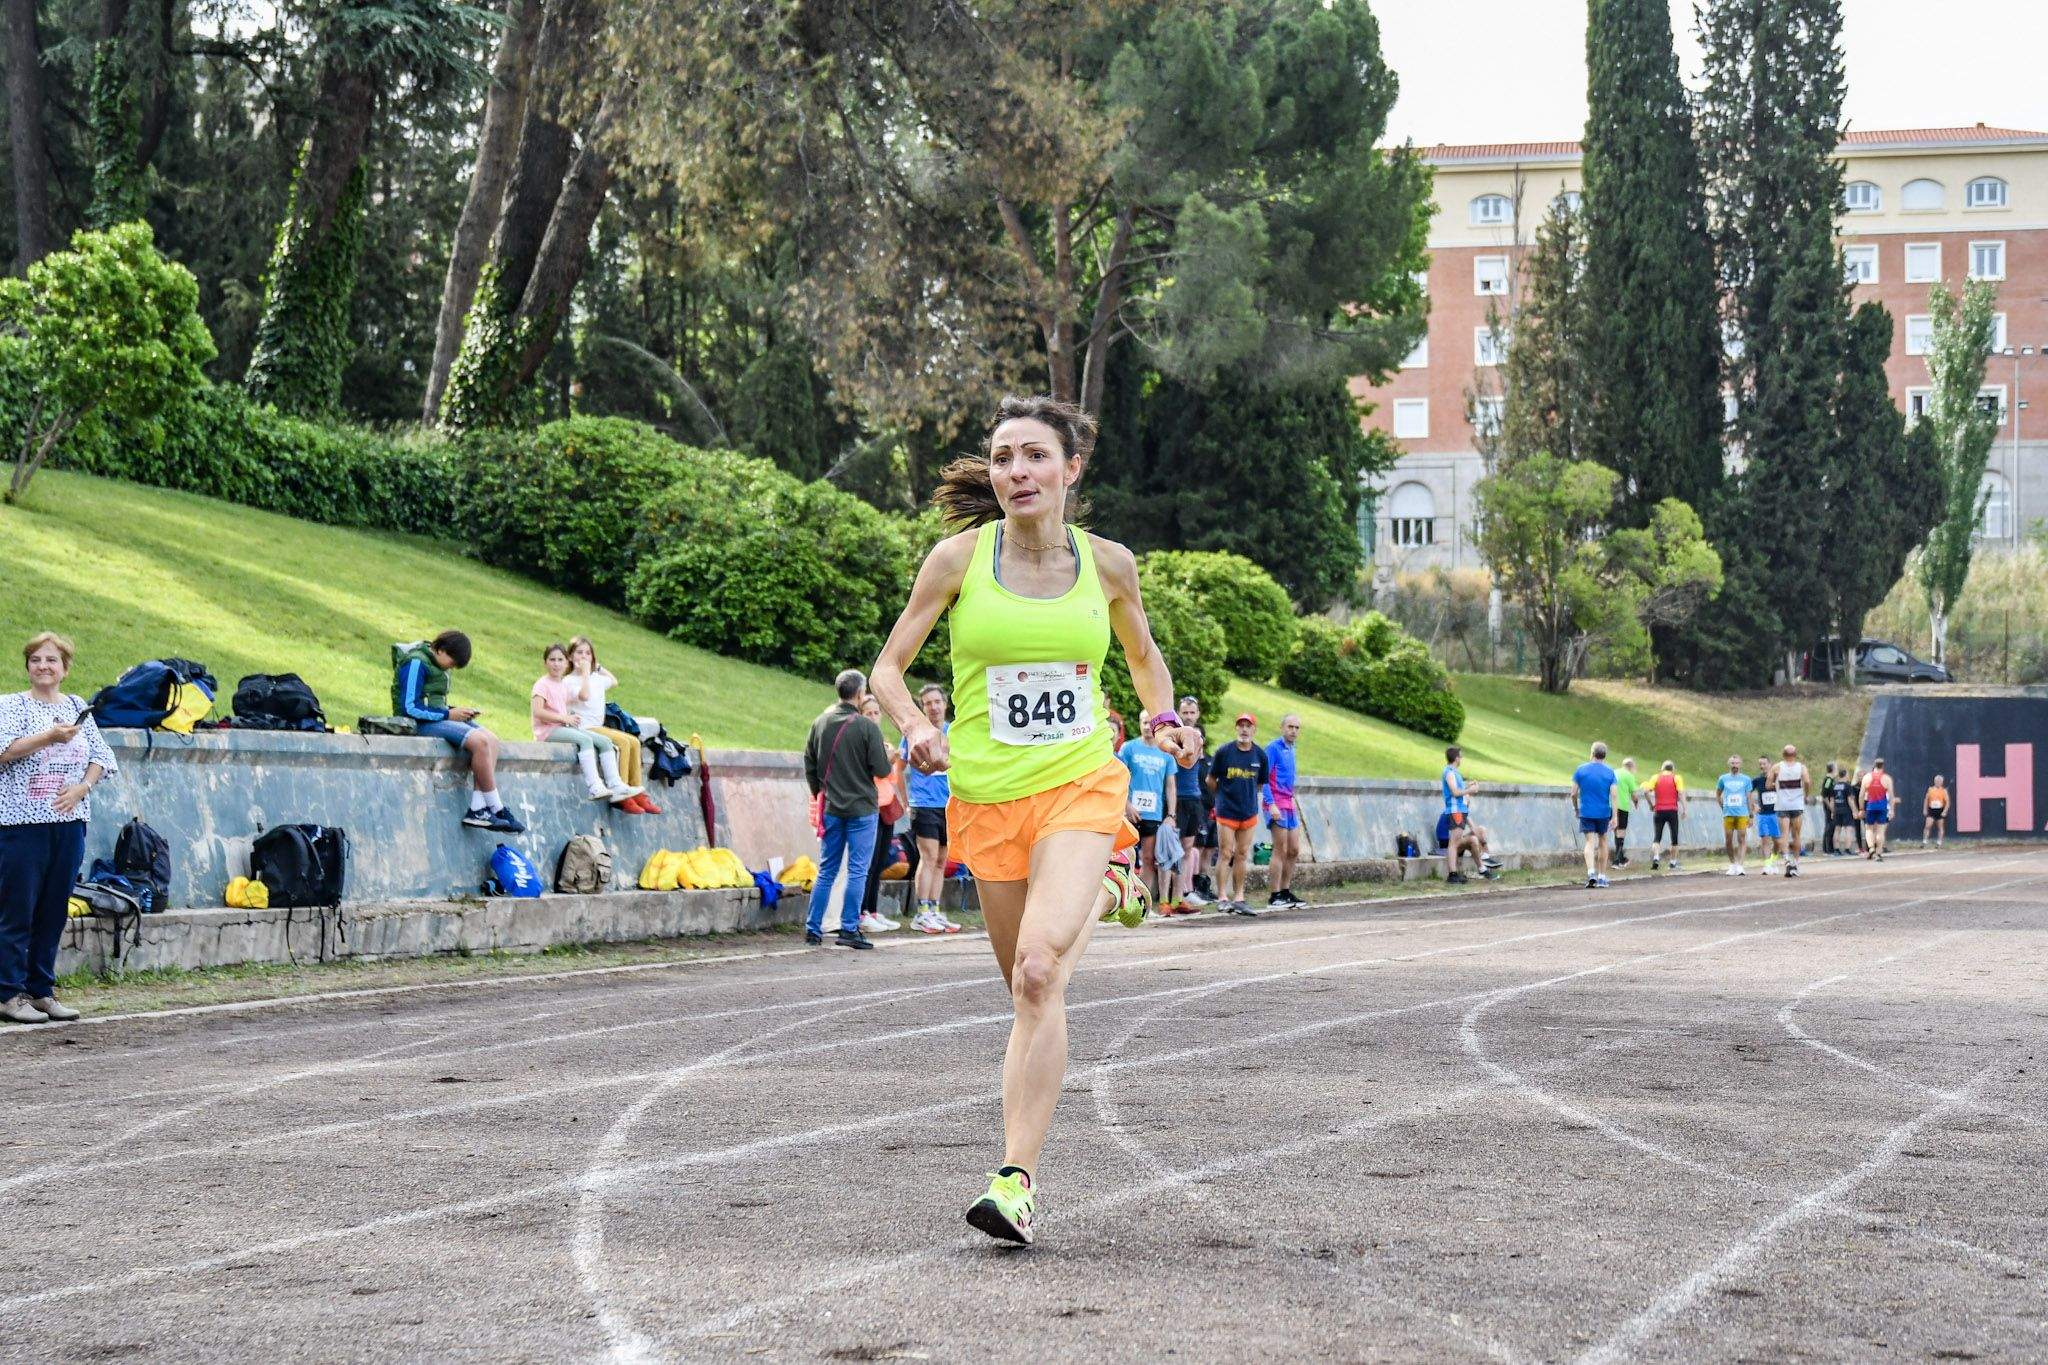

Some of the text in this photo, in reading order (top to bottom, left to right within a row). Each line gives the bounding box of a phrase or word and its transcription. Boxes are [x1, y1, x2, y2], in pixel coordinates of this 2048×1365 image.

[1008, 689, 1076, 728] 848
[1136, 797, 1153, 807] 722
[1956, 743, 2048, 831] H
